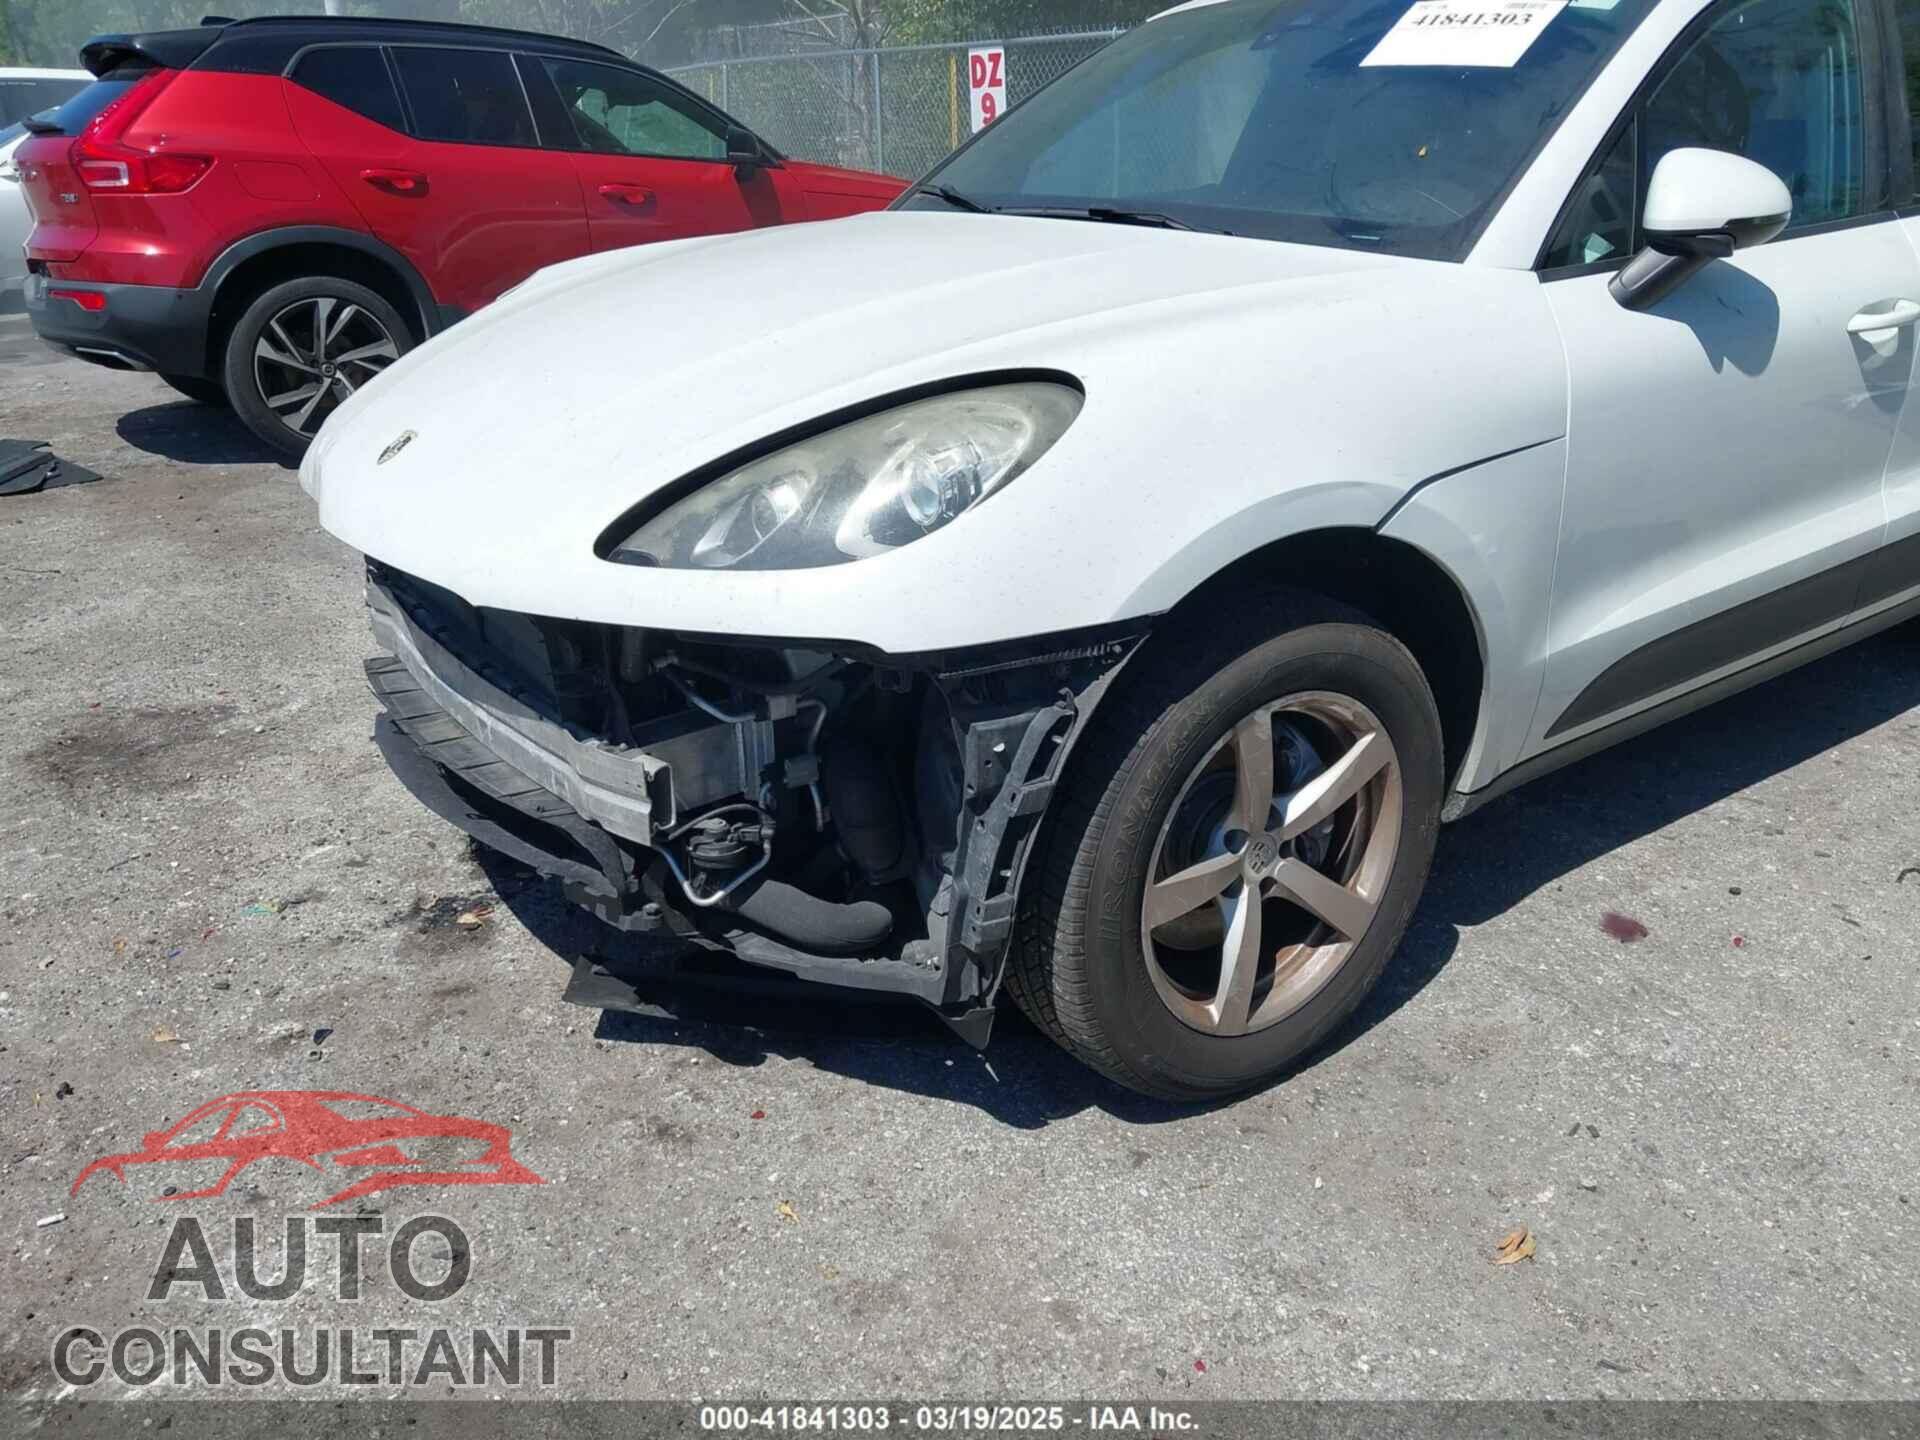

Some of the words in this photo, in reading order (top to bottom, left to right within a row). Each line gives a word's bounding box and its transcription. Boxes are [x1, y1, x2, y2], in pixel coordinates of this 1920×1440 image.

[1411, 13, 1533, 26] 41841303
[971, 53, 1003, 88] DZ
[981, 92, 997, 125] 9
